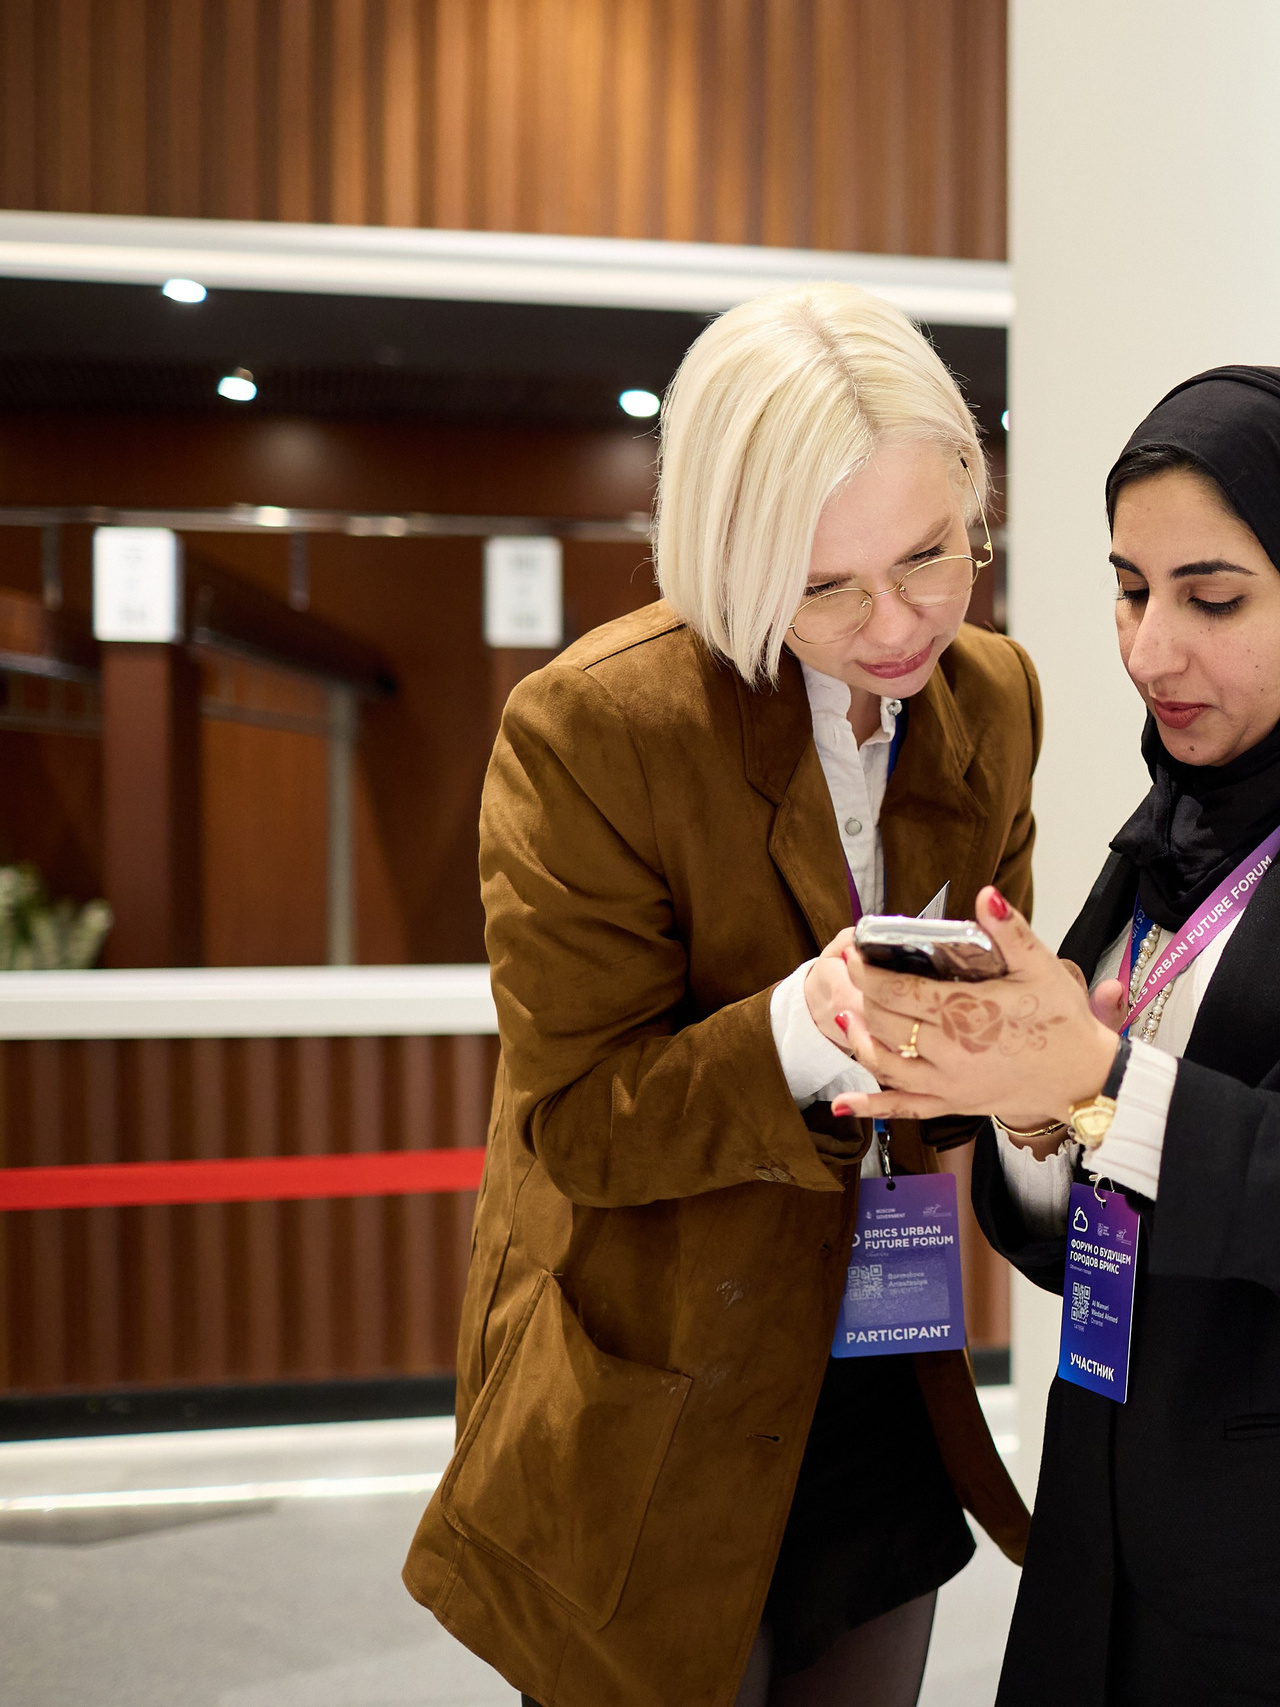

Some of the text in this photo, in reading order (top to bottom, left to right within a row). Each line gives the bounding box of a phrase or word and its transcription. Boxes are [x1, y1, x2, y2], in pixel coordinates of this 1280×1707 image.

[1148, 941, 1188, 986] URBAN
[1186, 895, 1233, 945] FUTURE
[1231, 854, 1273, 901] FORUM
[864, 1225, 941, 1239] BRICS URBAN
[865, 1235, 954, 1250] FUTURE FORUM
[1070, 1238, 1131, 1266] ФОРУМ О БУДУЩЕМ
[1070, 1250, 1098, 1268] ГОРОДОВ
[1098, 1260, 1120, 1275] БРИКС
[846, 1325, 951, 1344] PARTICIPANT
[1070, 1352, 1115, 1382] УЧАСТНИК
